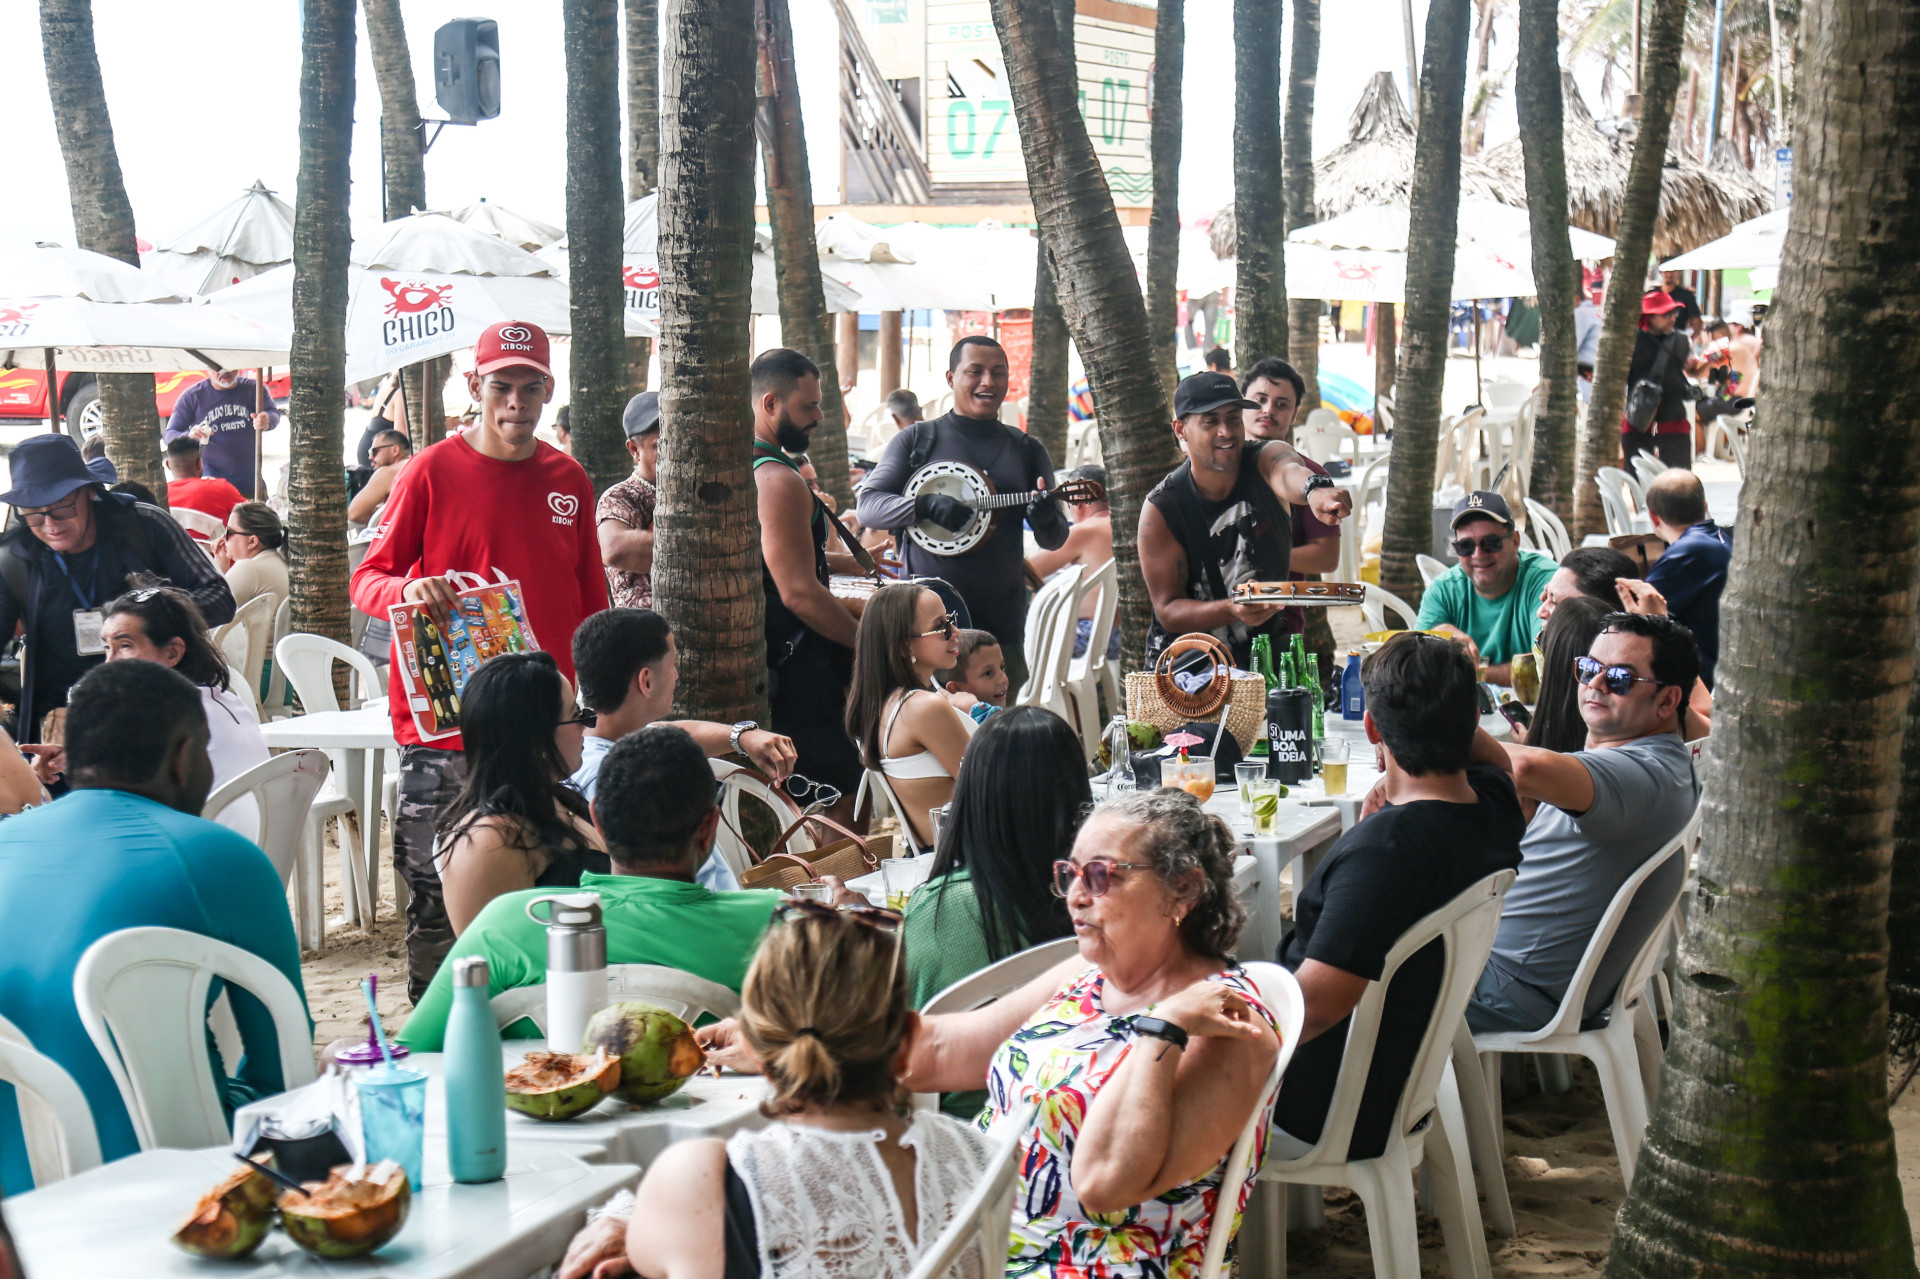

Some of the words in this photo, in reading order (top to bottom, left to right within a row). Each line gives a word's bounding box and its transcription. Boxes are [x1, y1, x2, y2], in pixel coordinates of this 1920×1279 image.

[949, 25, 994, 39] POST
[1104, 49, 1129, 65] POSTO
[1102, 77, 1130, 146] 07
[947, 100, 1010, 160] 07
[624, 290, 659, 309] HIC
[383, 307, 455, 346] CHICO
[501, 343, 531, 352] KIBON
[1468, 492, 1483, 508] LA
[552, 515, 572, 527] KIBON
[1280, 729, 1307, 741] UMA
[1272, 740, 1298, 752] BOA
[1279, 751, 1307, 763] IDEIA
